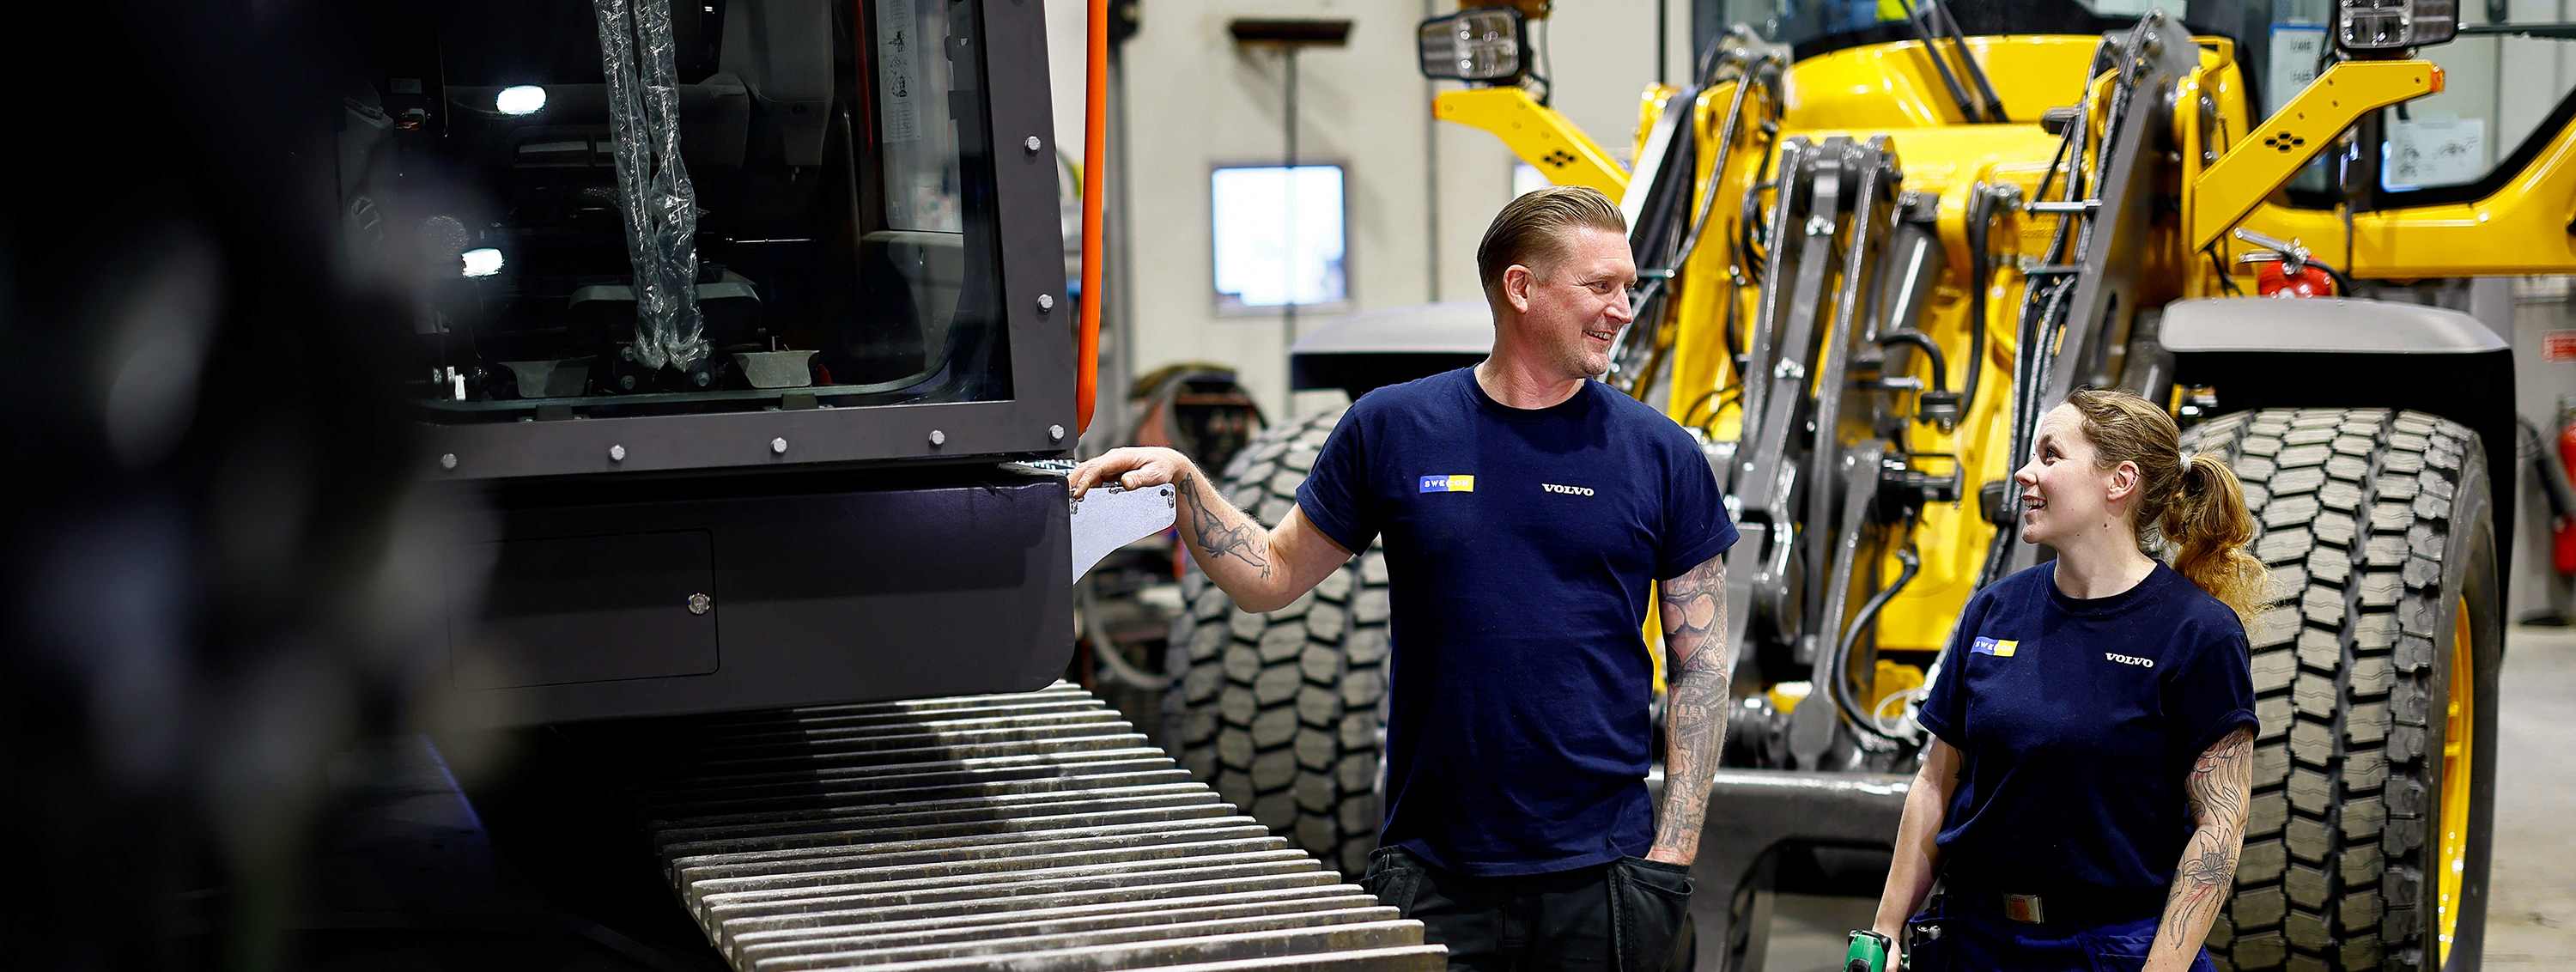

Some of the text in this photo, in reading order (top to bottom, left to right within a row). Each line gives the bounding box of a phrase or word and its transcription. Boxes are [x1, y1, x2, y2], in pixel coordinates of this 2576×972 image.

[1425, 479, 1469, 488] SWECON
[1541, 483, 1595, 496] VOLVO
[1975, 641, 2014, 653] SWECON
[2105, 653, 2154, 668] VOLVO
